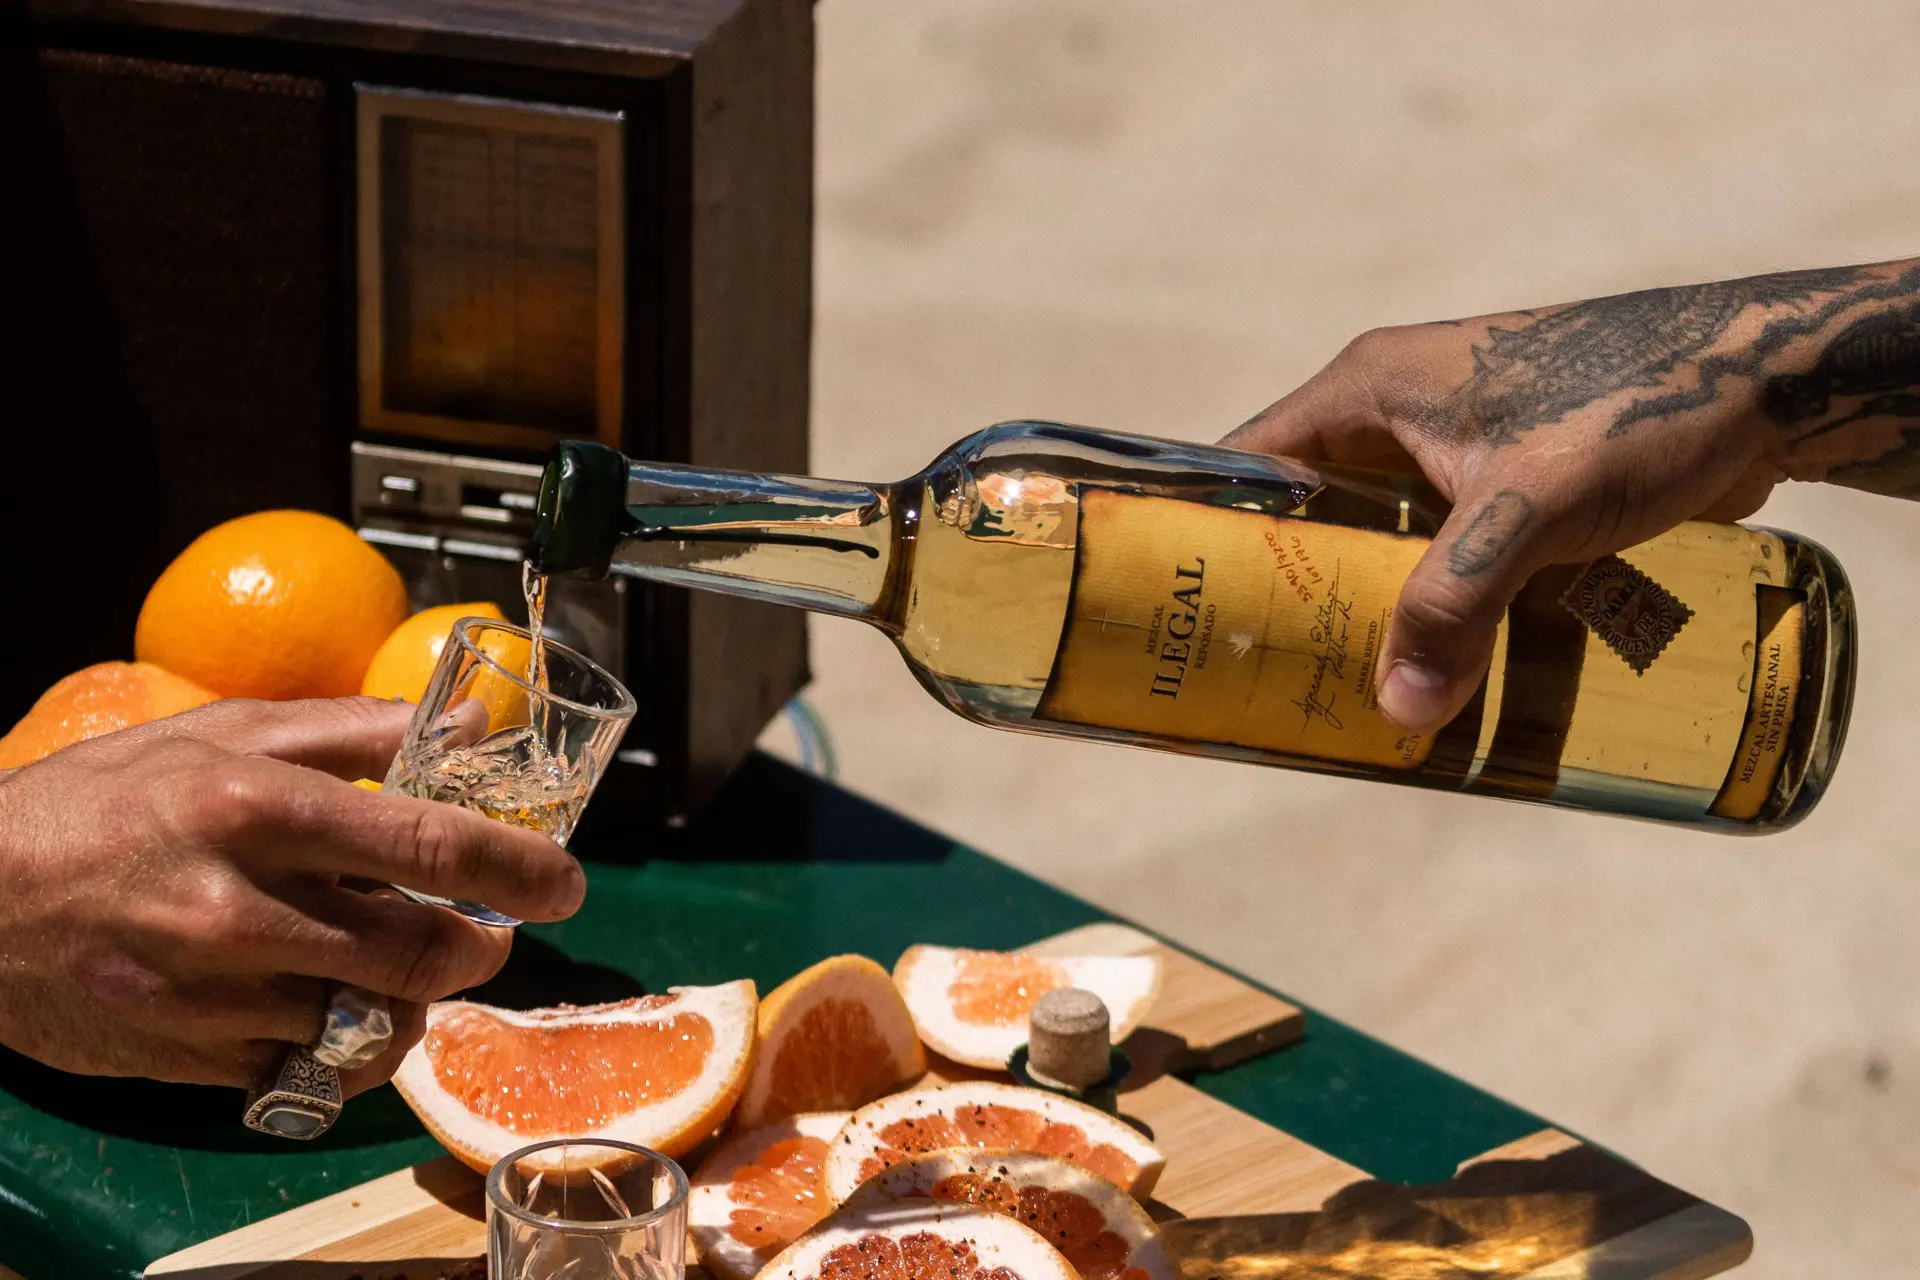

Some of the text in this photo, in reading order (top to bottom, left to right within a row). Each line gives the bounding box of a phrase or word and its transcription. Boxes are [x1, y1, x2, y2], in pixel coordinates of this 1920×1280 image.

[1144, 604, 1165, 655] MEZCAL
[1149, 556, 1205, 700] ILEGAL
[1194, 603, 1217, 670] REPOSADO
[1355, 620, 1378, 696] BARREL RESTED
[1740, 643, 1781, 784] MEZCAL ARTESANAL
[1765, 684, 1791, 753] SIN PRISA
